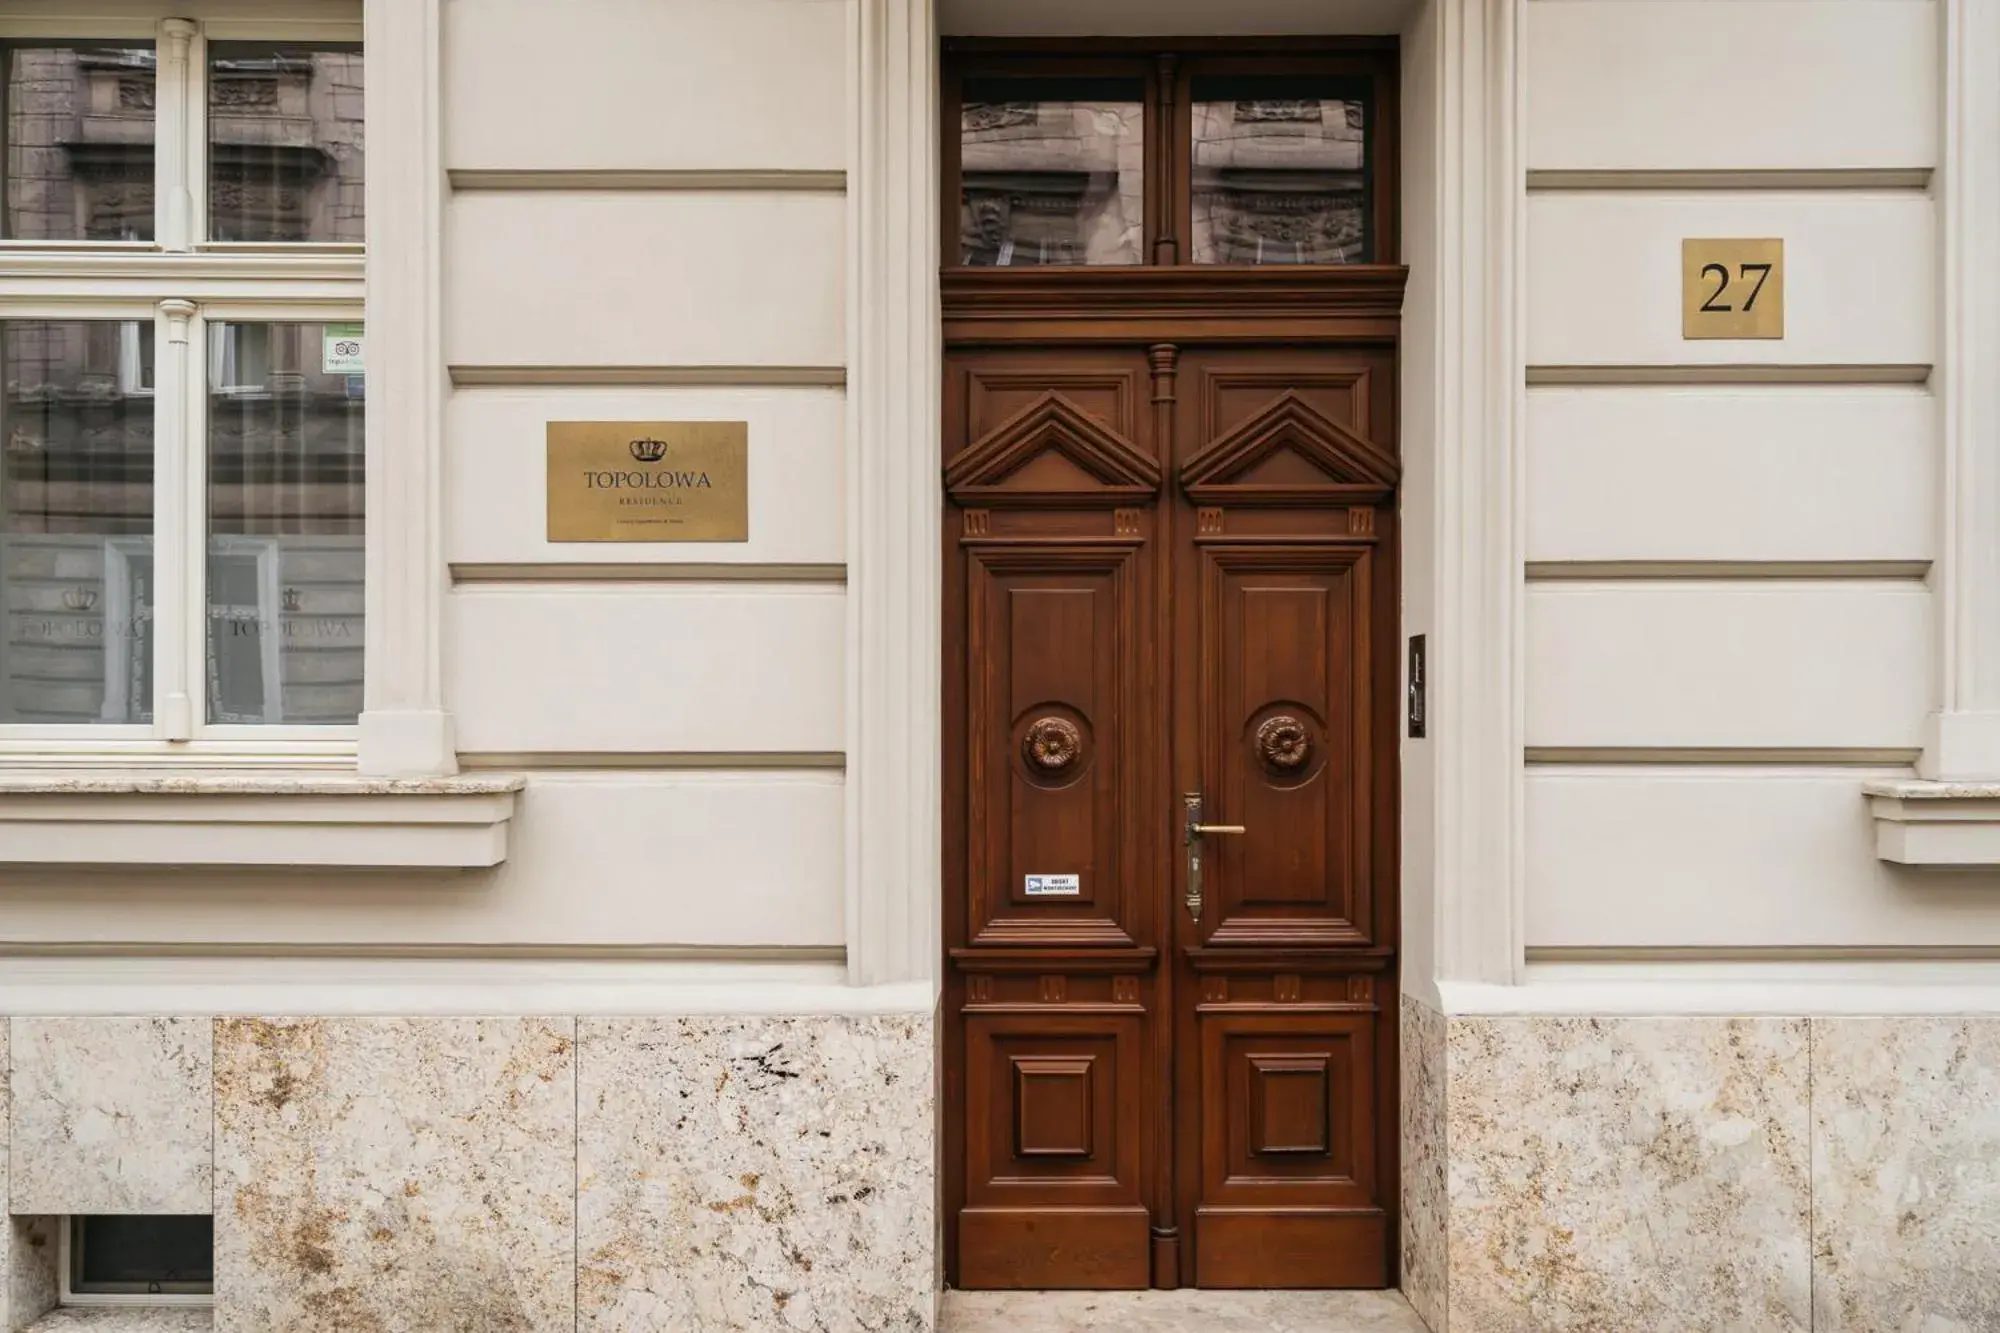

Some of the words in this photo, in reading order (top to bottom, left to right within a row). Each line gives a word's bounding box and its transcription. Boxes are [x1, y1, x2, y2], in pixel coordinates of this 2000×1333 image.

[1699, 263, 1772, 312] 27
[583, 471, 712, 489] TOPOLOWA
[619, 496, 682, 505] RESIDENCE
[21, 619, 139, 638] OPLOWA
[228, 619, 352, 637] TOPLWA
